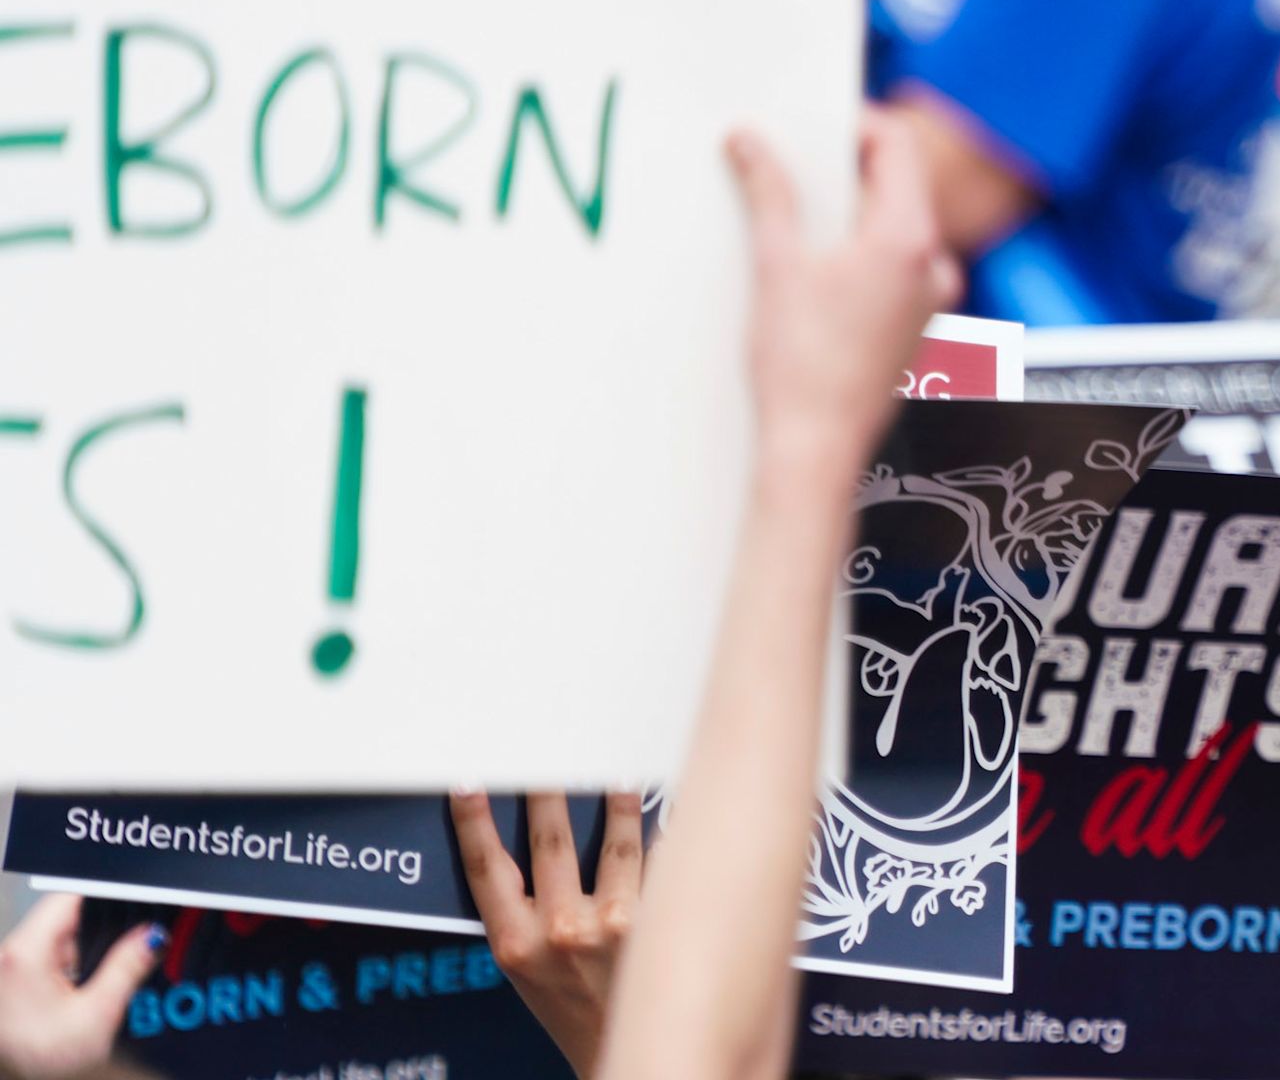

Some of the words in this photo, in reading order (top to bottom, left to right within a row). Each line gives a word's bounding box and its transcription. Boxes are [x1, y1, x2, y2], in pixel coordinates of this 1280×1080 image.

[1080, 721, 1262, 861] all
[64, 805, 424, 885] StudentsforLife.org
[130, 967, 285, 1040] BORN
[297, 960, 339, 1013] &
[808, 1003, 1128, 1053] StudentsforLife.org
